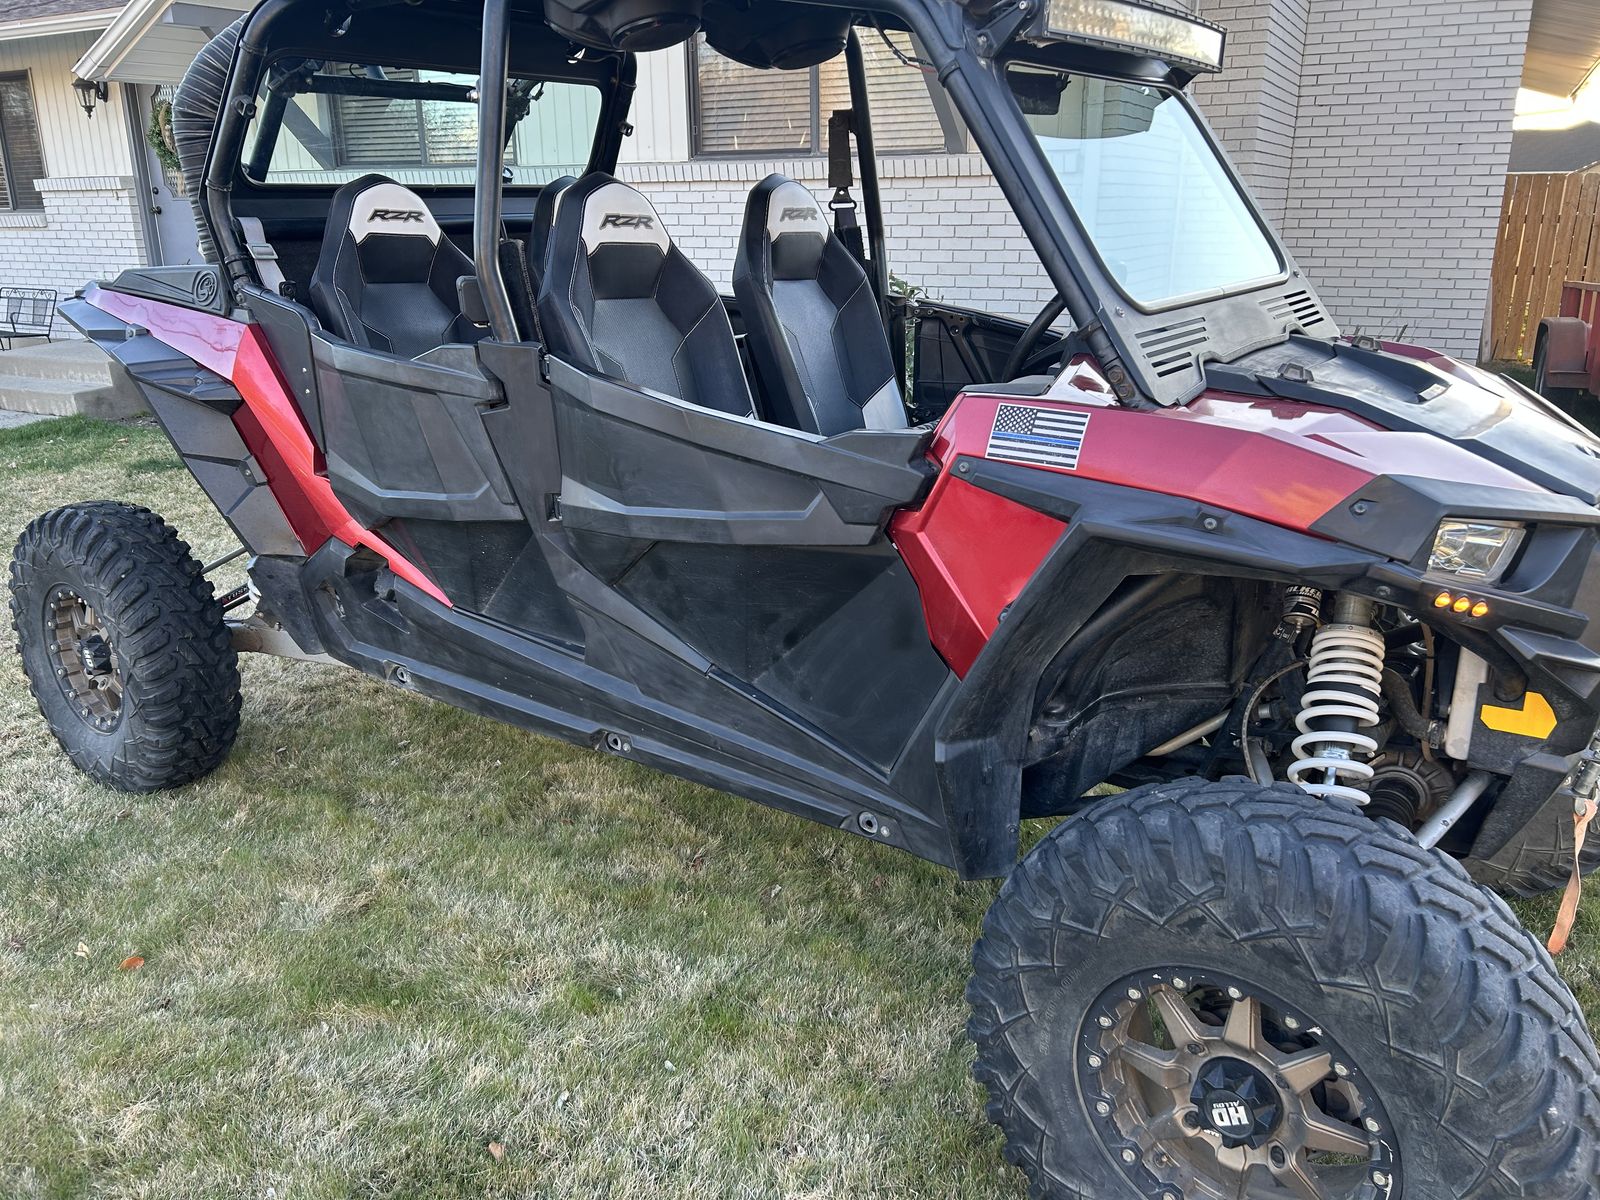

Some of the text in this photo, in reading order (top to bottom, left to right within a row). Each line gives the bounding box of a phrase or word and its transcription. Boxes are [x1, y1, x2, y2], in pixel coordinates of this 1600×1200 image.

[367, 209, 425, 223] RZR
[599, 213, 654, 230] RZR
[780, 207, 817, 222] RZR
[1213, 1100, 1239, 1108] ALLOY
[1211, 1105, 1249, 1127] HD
